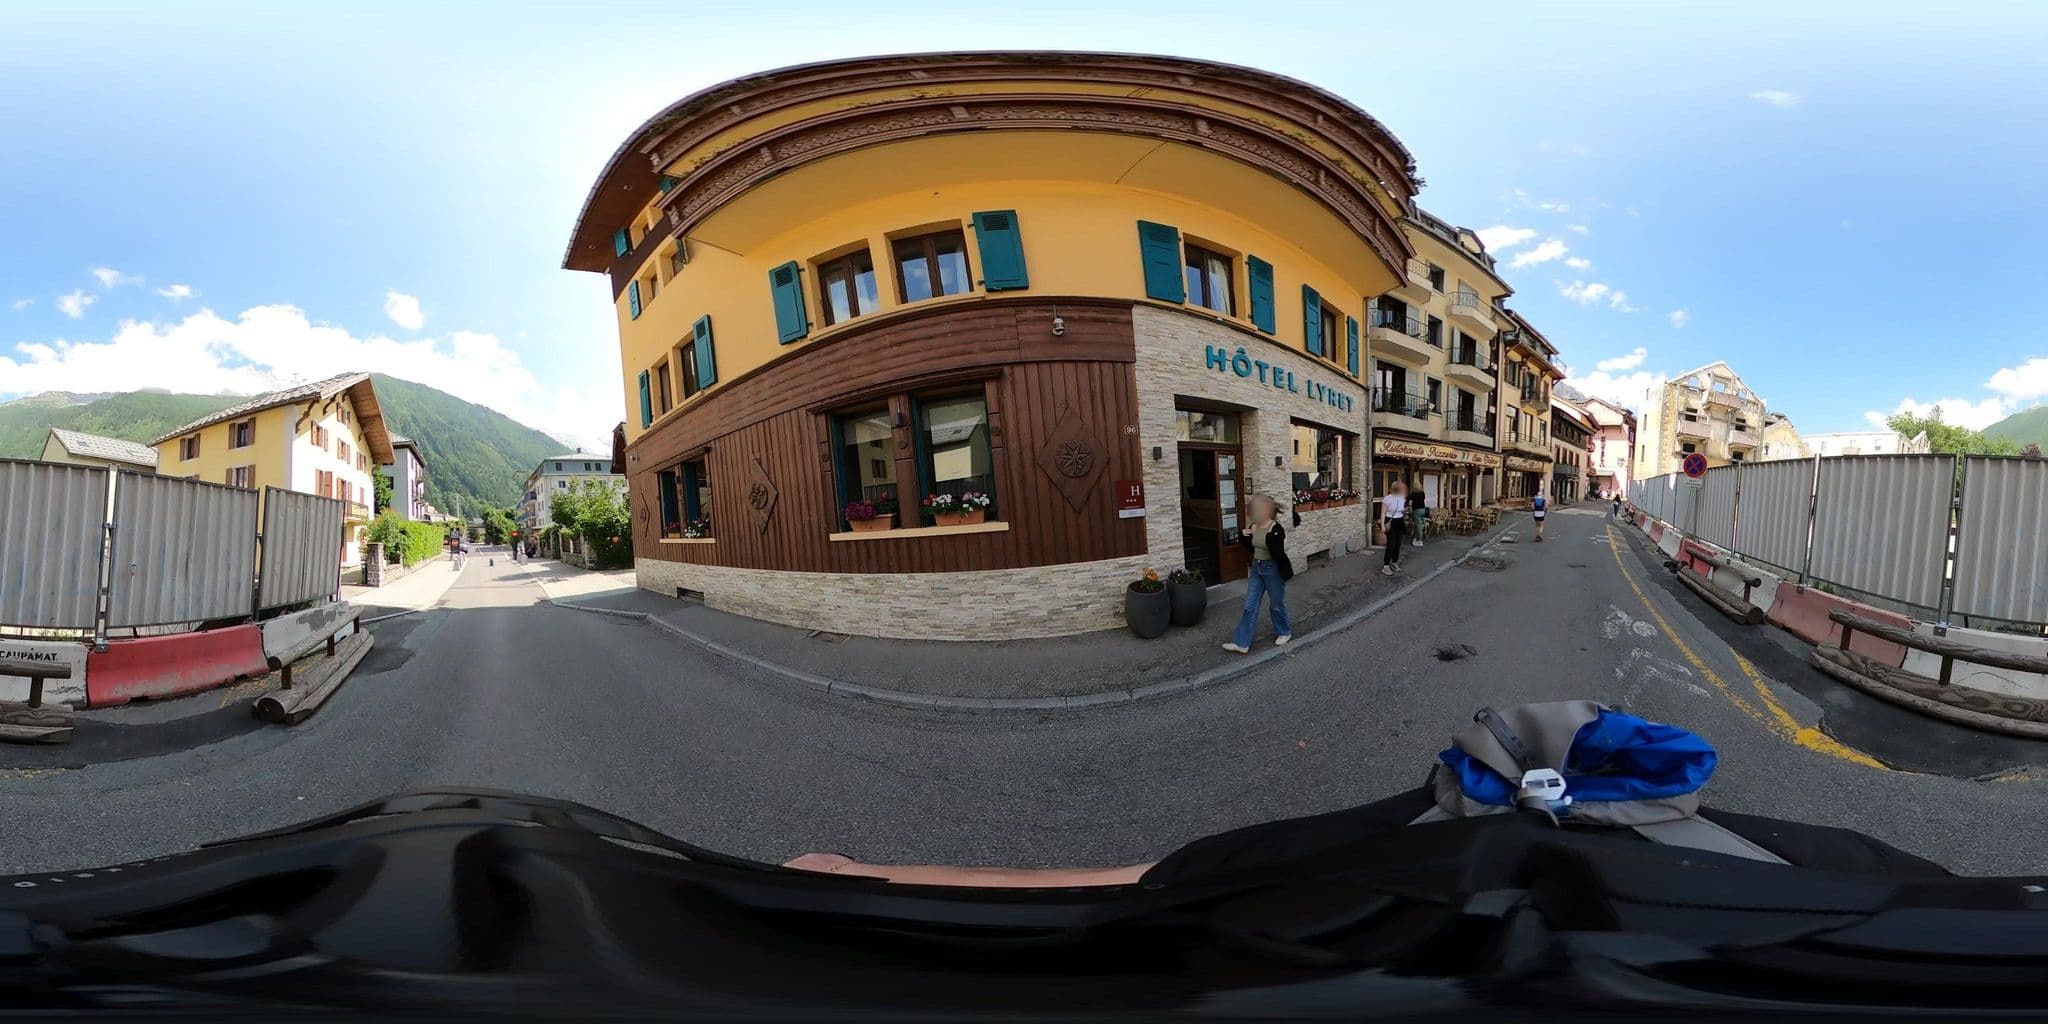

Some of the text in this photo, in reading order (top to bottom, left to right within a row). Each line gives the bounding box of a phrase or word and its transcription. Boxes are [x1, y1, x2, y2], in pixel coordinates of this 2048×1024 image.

[1206, 345, 1354, 412] HÔTEL LYRET
[1126, 426, 1137, 434] 96
[1380, 440, 1425, 456] Ristorante
[1130, 485, 1141, 496] H
